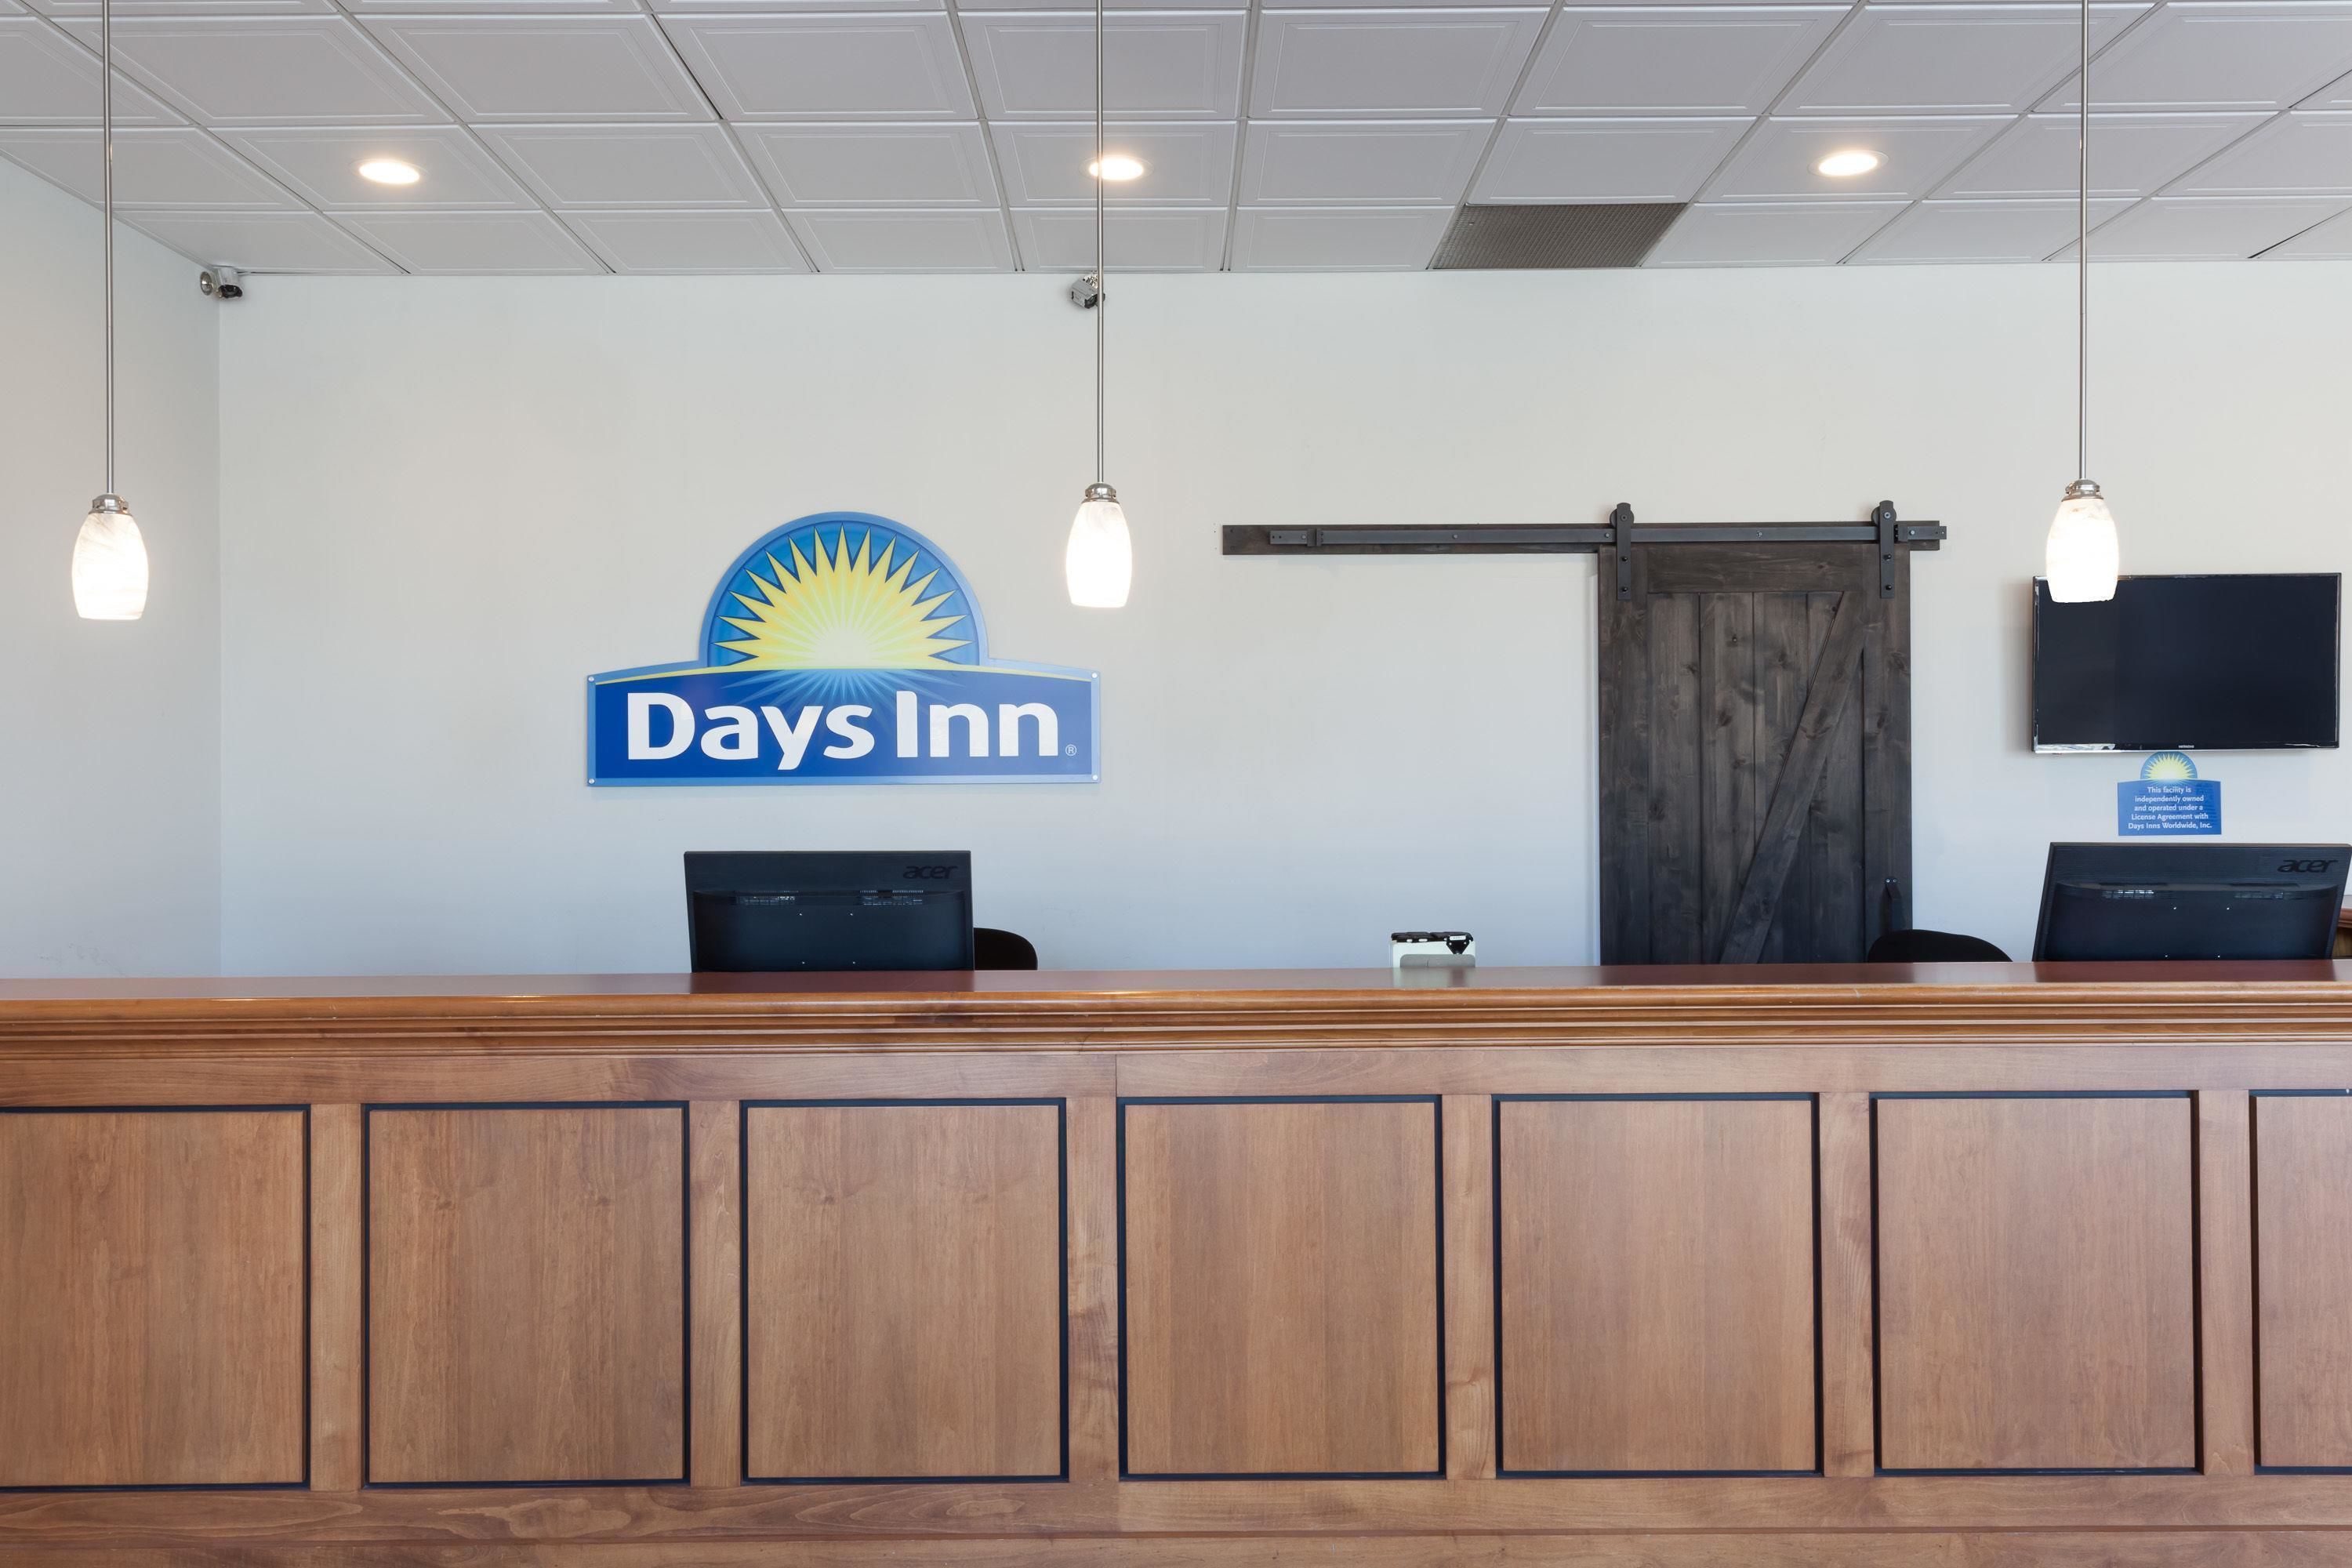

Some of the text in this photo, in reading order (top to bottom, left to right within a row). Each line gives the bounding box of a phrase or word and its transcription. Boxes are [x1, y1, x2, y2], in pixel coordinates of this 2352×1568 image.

[627, 692, 875, 770] Days
[896, 691, 1058, 758] Inn
[2148, 804, 2176, 813] operated
[903, 866, 958, 879] acer
[2278, 860, 2339, 873] acer
